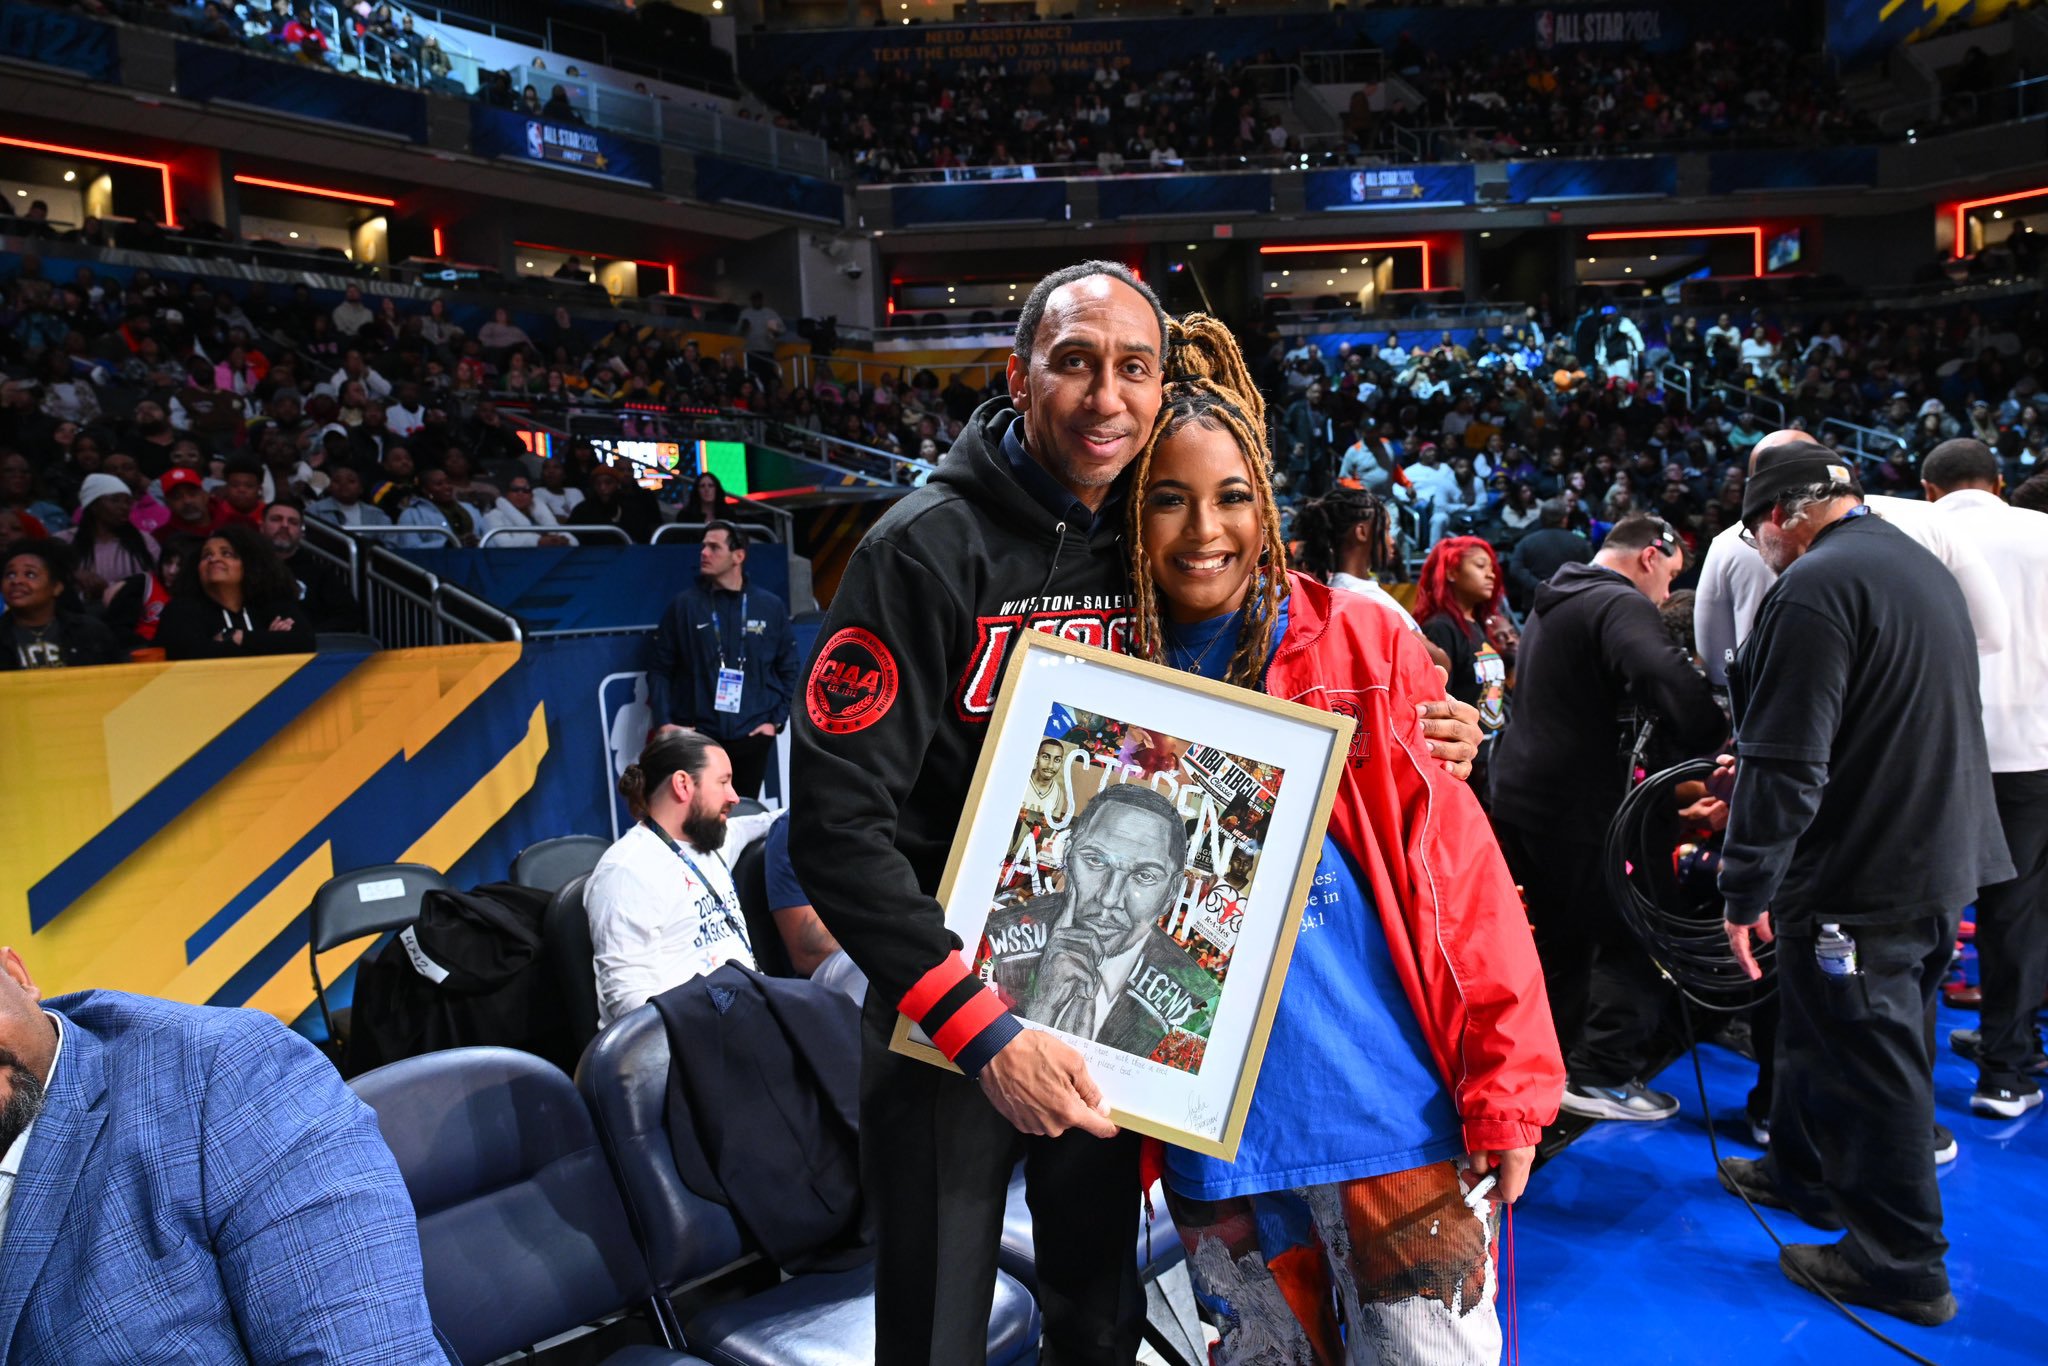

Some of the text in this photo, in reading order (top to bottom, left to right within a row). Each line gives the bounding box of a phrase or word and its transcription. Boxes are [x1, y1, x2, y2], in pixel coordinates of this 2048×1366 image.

[925, 25, 1073, 45] NEED ASSISTANCE?
[1555, 13, 1581, 43] ALL
[1584, 12, 1624, 42] STAR
[873, 47, 911, 62] TEXT
[916, 46, 945, 61] THE
[949, 44, 994, 59] ISSUE
[999, 43, 1018, 57] TO
[818, 659, 881, 694] CIAA
[1196, 746, 1226, 775] NBA
[1210, 777, 1233, 798] Classic
[1311, 871, 1337, 886] es:
[1323, 890, 1340, 905] in
[988, 922, 1047, 955] WSSU
[1127, 953, 1193, 1026] LEGEND
